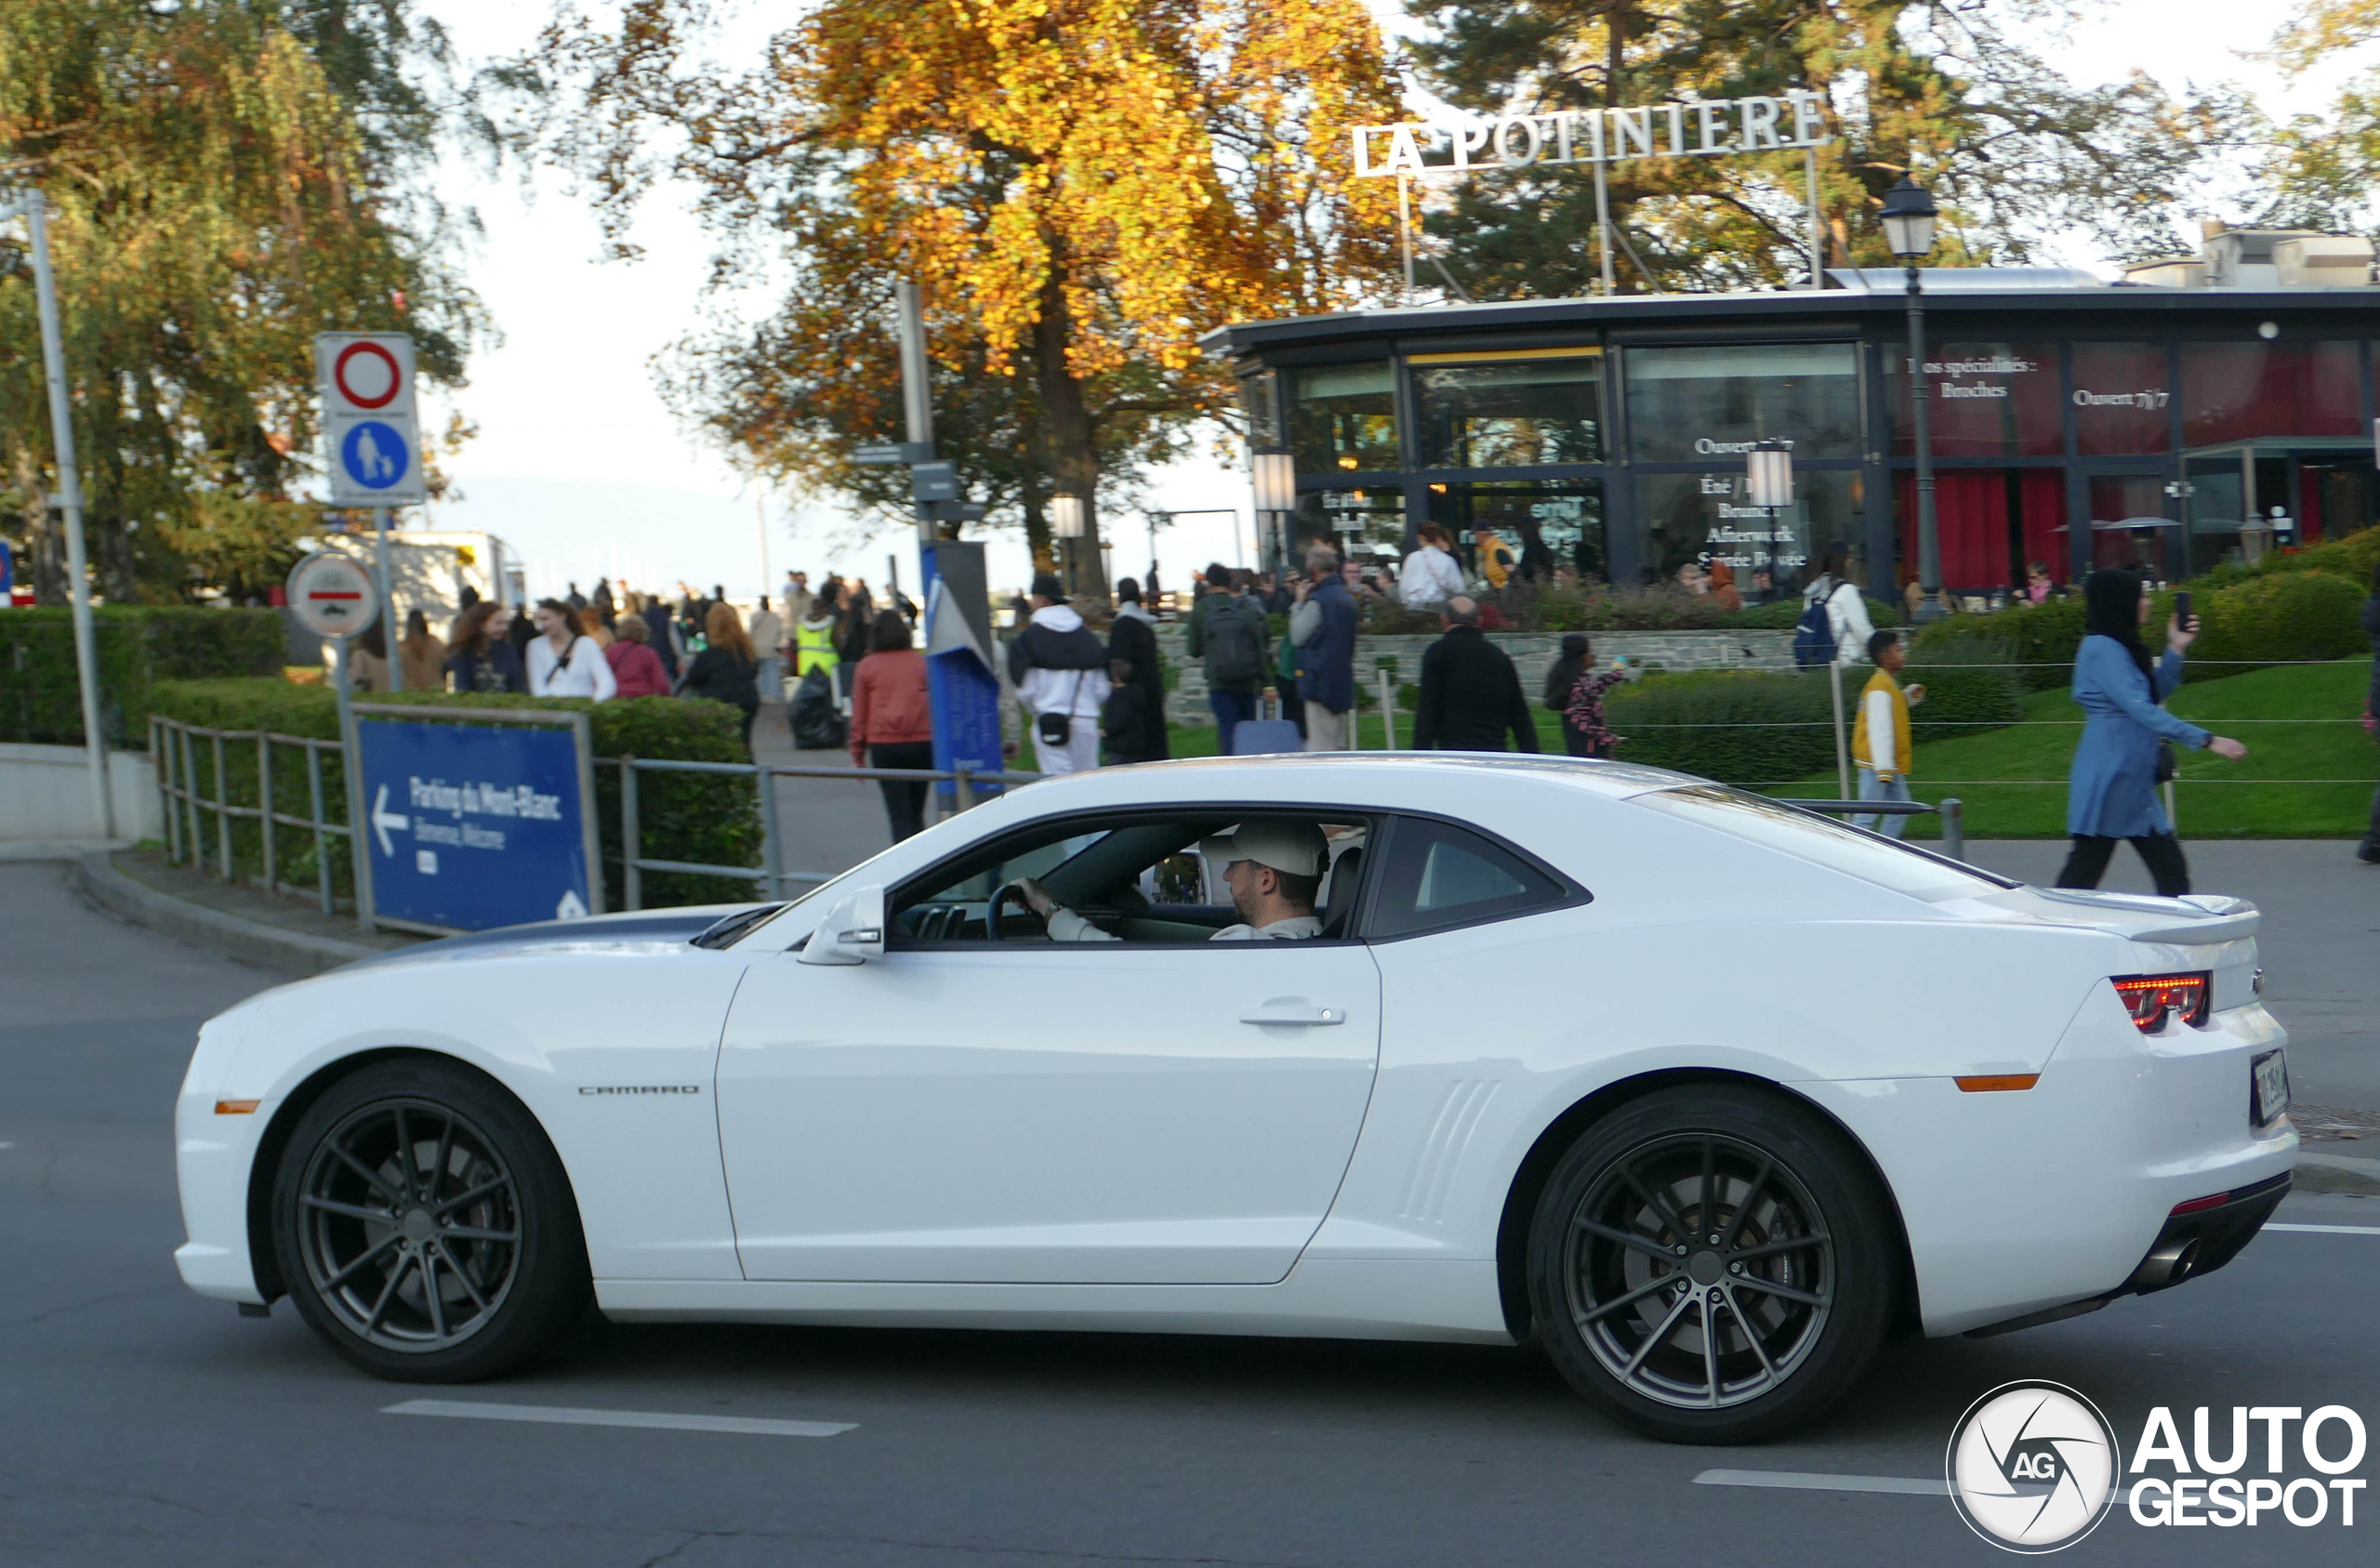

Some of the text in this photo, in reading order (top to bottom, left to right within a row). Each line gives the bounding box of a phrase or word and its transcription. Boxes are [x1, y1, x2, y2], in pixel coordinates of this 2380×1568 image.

[1352, 91, 1832, 177] LA POTINIERE
[2072, 389, 2135, 405] Ouvert
[409, 775, 562, 821] Parking du Mont-Blanc
[578, 1086, 700, 1095] CAMARO
